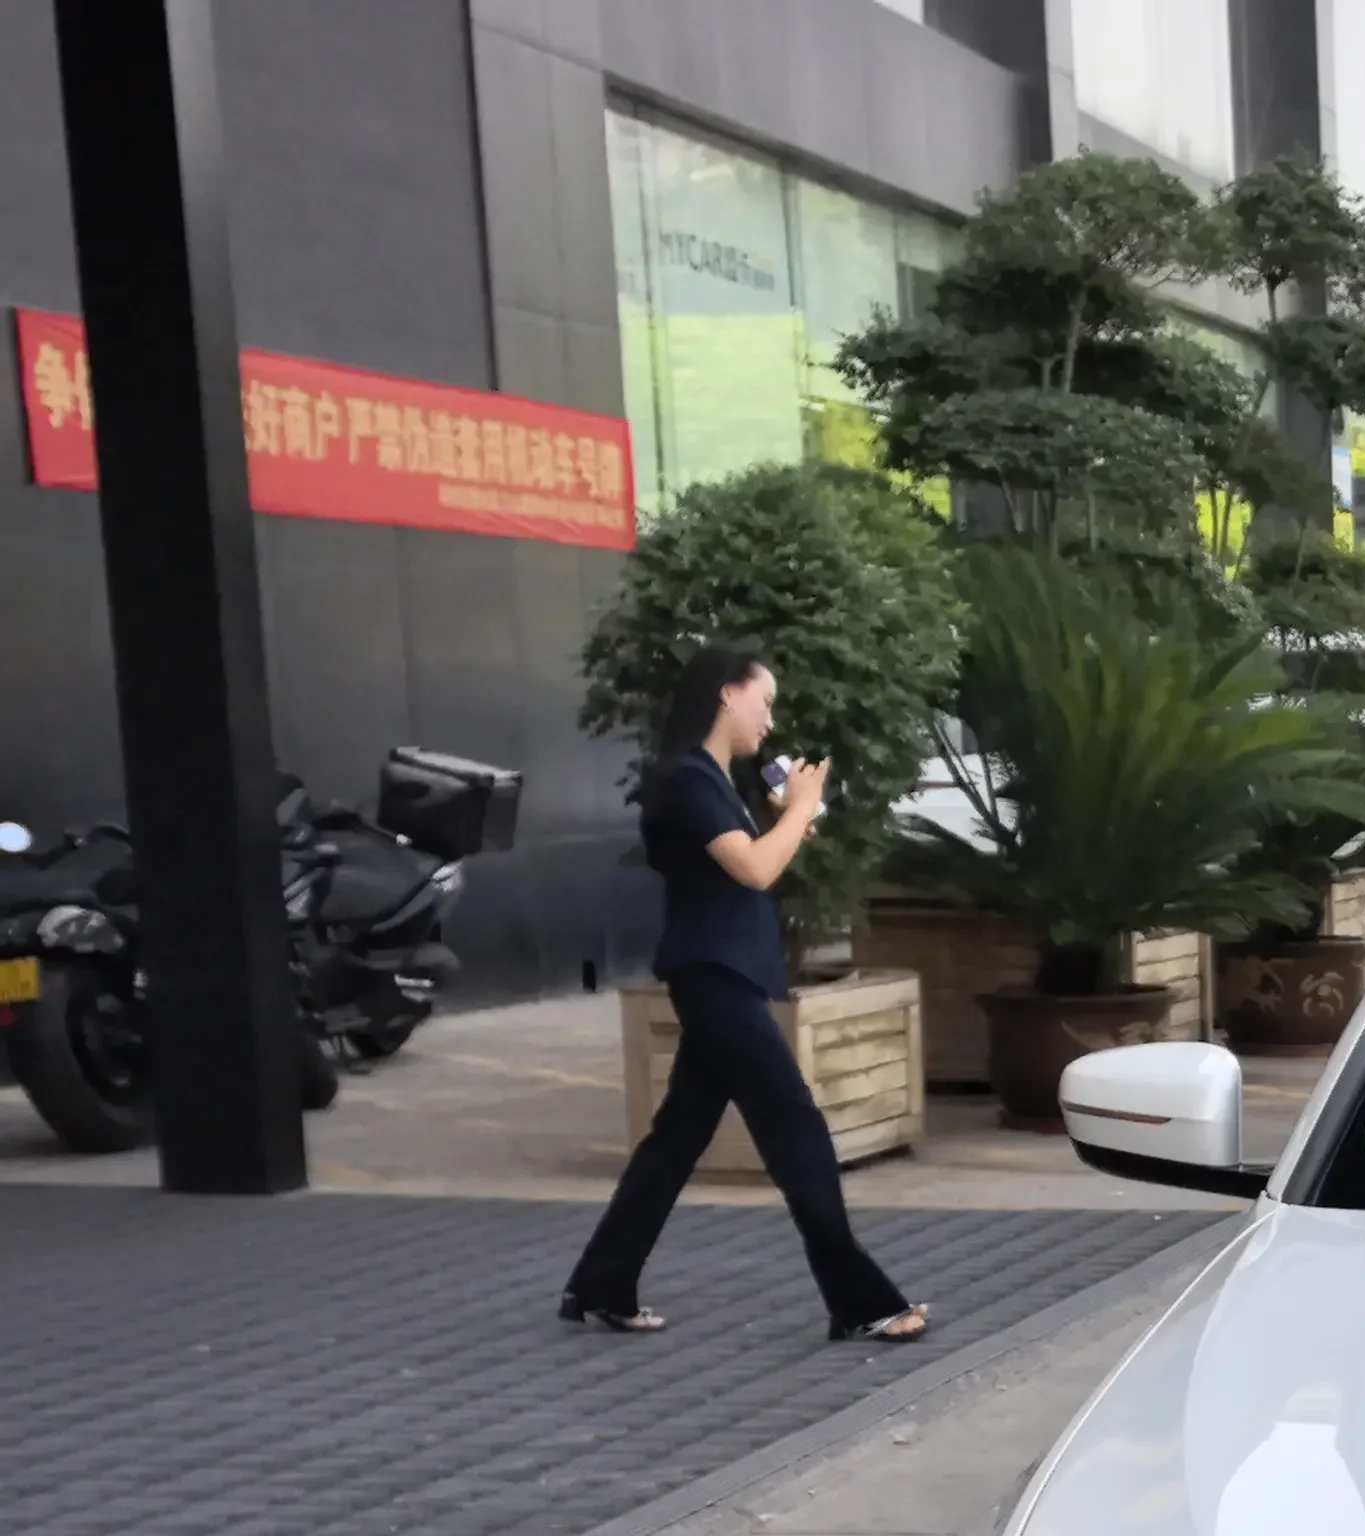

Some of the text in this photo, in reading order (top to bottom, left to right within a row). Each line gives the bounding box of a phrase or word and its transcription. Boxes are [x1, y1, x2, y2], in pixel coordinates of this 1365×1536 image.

[243, 378, 624, 500] 好商户严禁伪造套用机动车号牌
